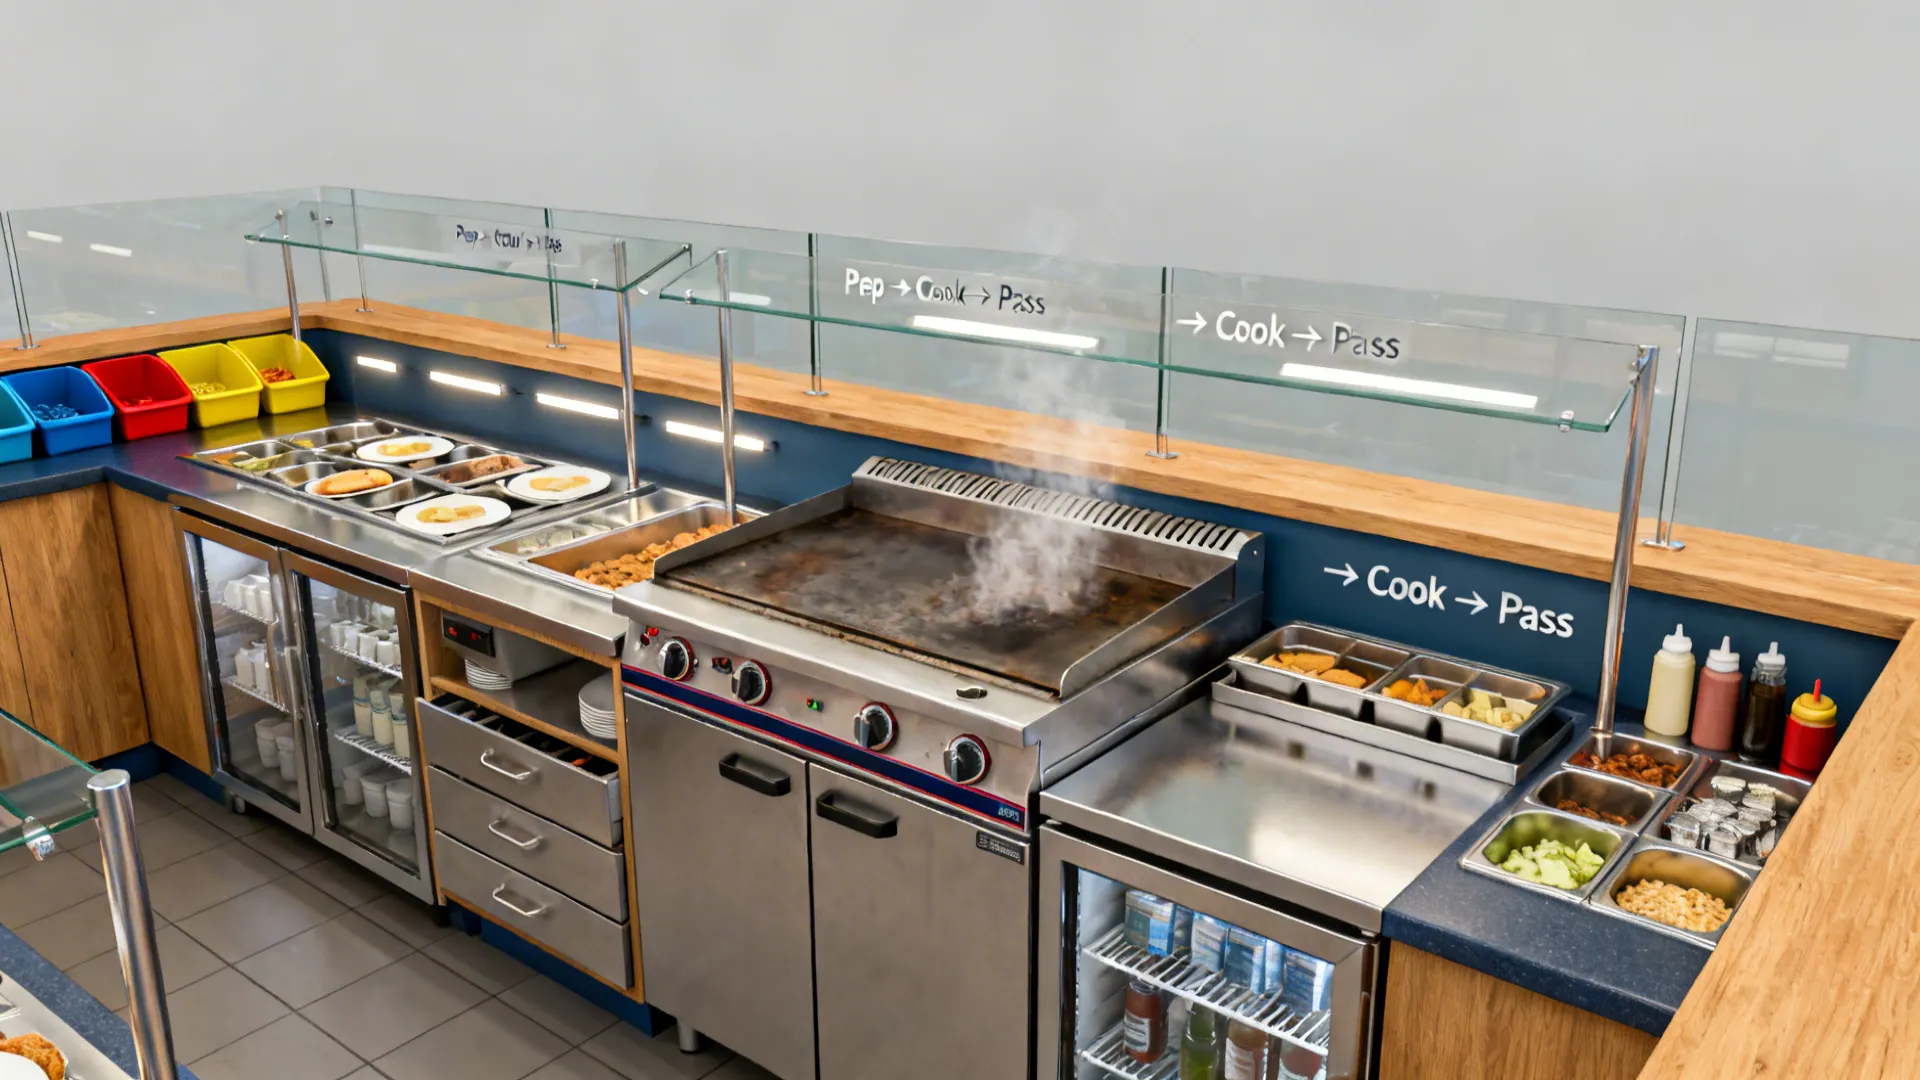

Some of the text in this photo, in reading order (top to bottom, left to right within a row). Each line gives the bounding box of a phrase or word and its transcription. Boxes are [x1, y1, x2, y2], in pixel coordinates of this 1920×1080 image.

[845, 268, 885, 305] Pep
[1216, 310, 1401, 359] Cook Pass
[1367, 565, 1575, 638] Cook Pass
